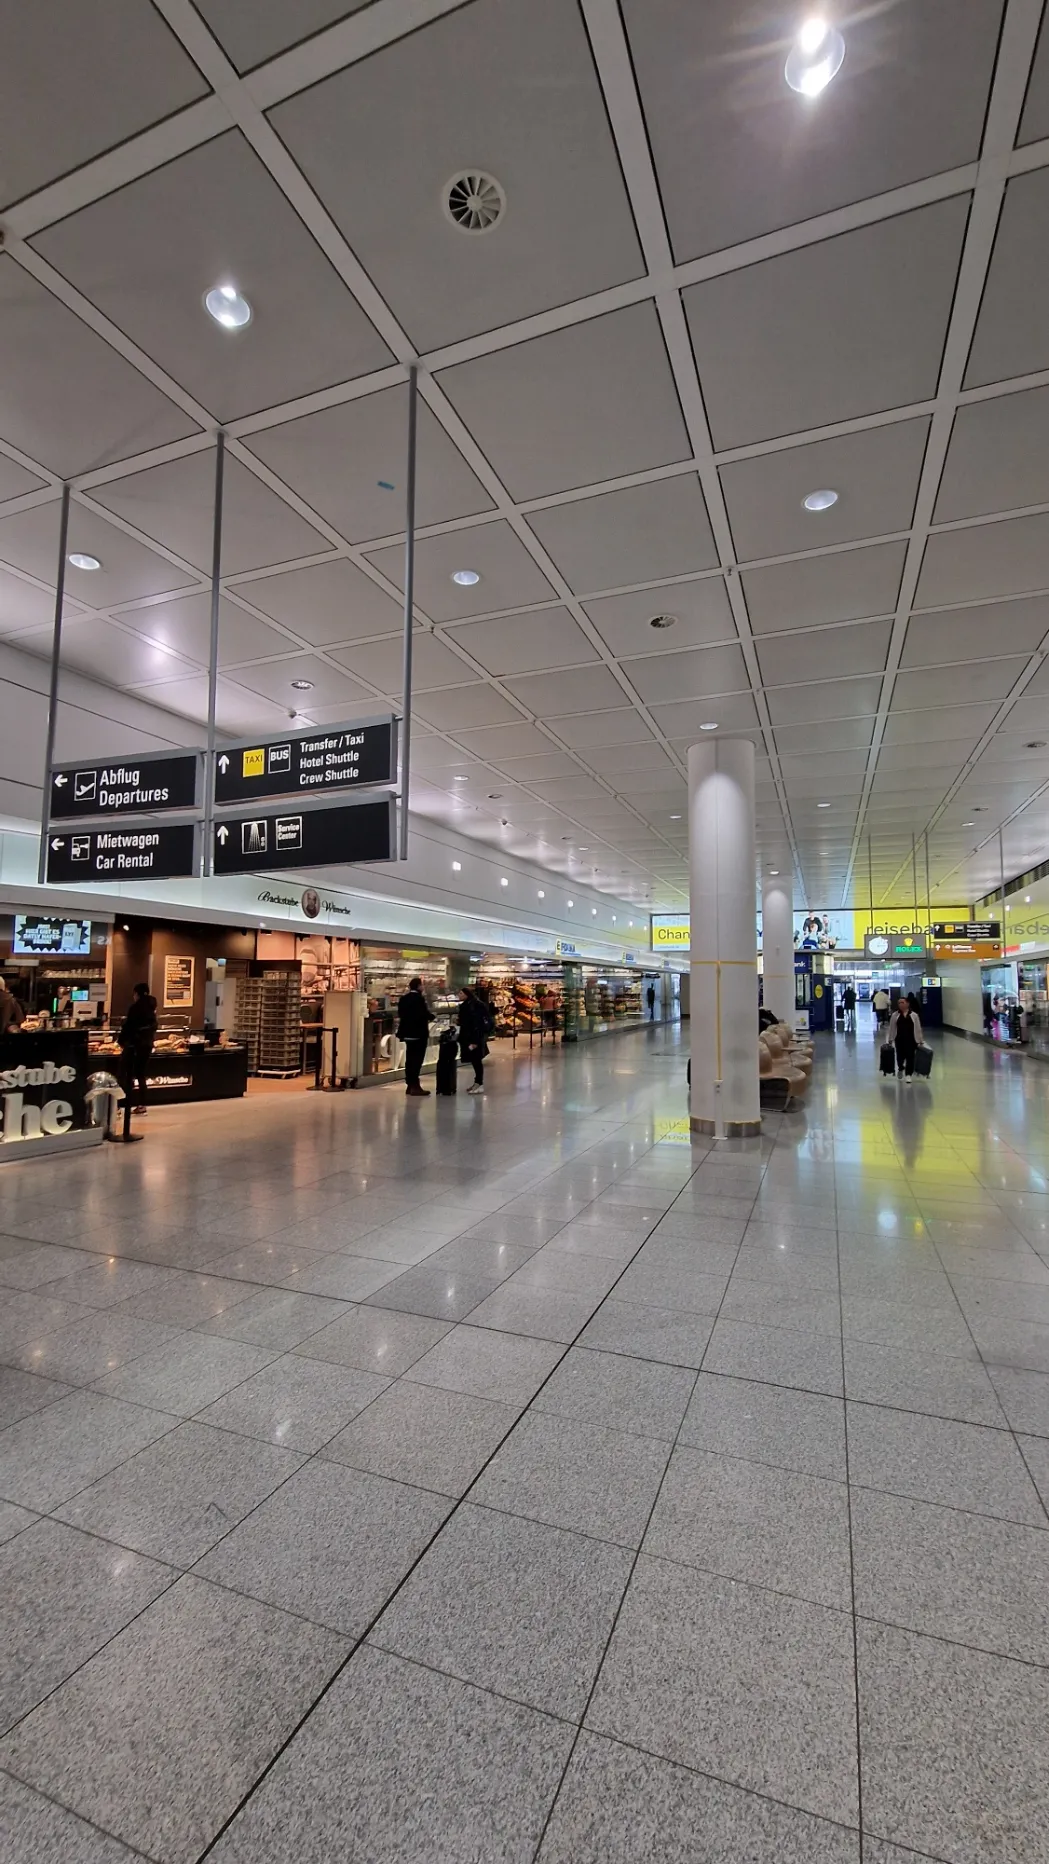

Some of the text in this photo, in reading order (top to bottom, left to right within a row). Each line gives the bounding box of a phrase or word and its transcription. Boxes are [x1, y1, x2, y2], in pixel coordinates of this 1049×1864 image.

[300, 732, 365, 753] Transfer / Taxi
[245, 754, 263, 765] TAXI
[270, 749, 289, 762] BUS
[299, 750, 360, 769] Hotel Shuttle
[99, 768, 141, 788] Abflug
[299, 766, 359, 785] Crew Shuttle
[98, 787, 169, 808] Departures
[278, 823, 300, 833] Service
[278, 832, 298, 841] Center
[96, 832, 160, 850] Mietwagen
[95, 851, 154, 870] Car Rental
[257, 890, 300, 907] Backstube
[895, 945, 923, 953] ROLEX
[0, 1092, 73, 1142] he
